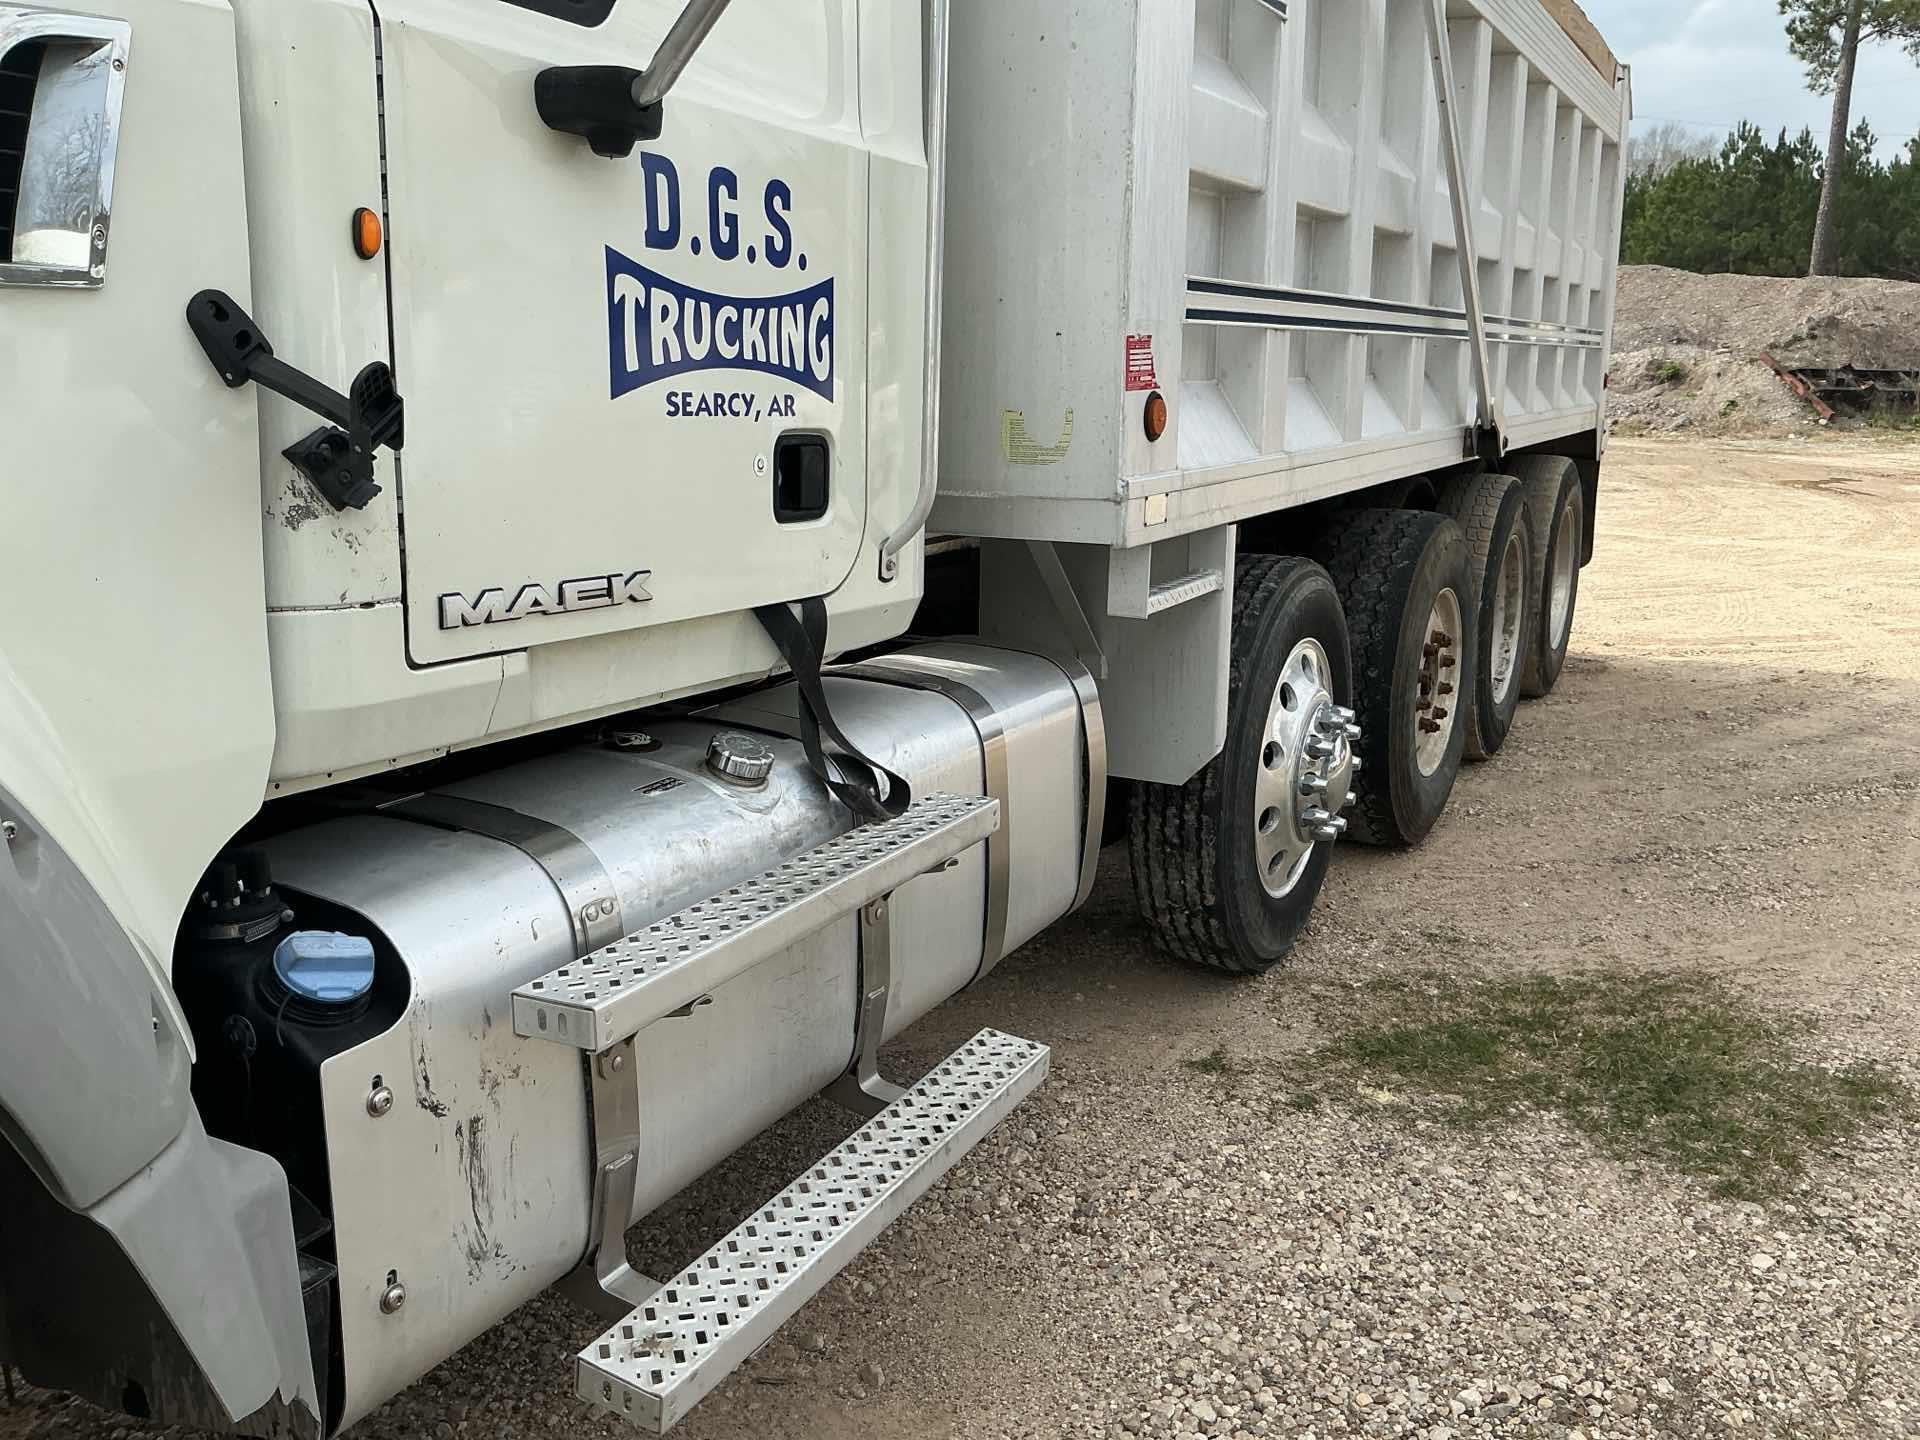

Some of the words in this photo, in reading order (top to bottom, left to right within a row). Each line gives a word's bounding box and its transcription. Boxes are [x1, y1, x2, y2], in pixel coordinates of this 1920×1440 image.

[640, 151, 808, 271] D.G.S.
[613, 273, 831, 382] TRUCKING
[665, 391, 761, 423] SEARCY,
[767, 394, 796, 417] AR
[439, 569, 653, 630] MACK
